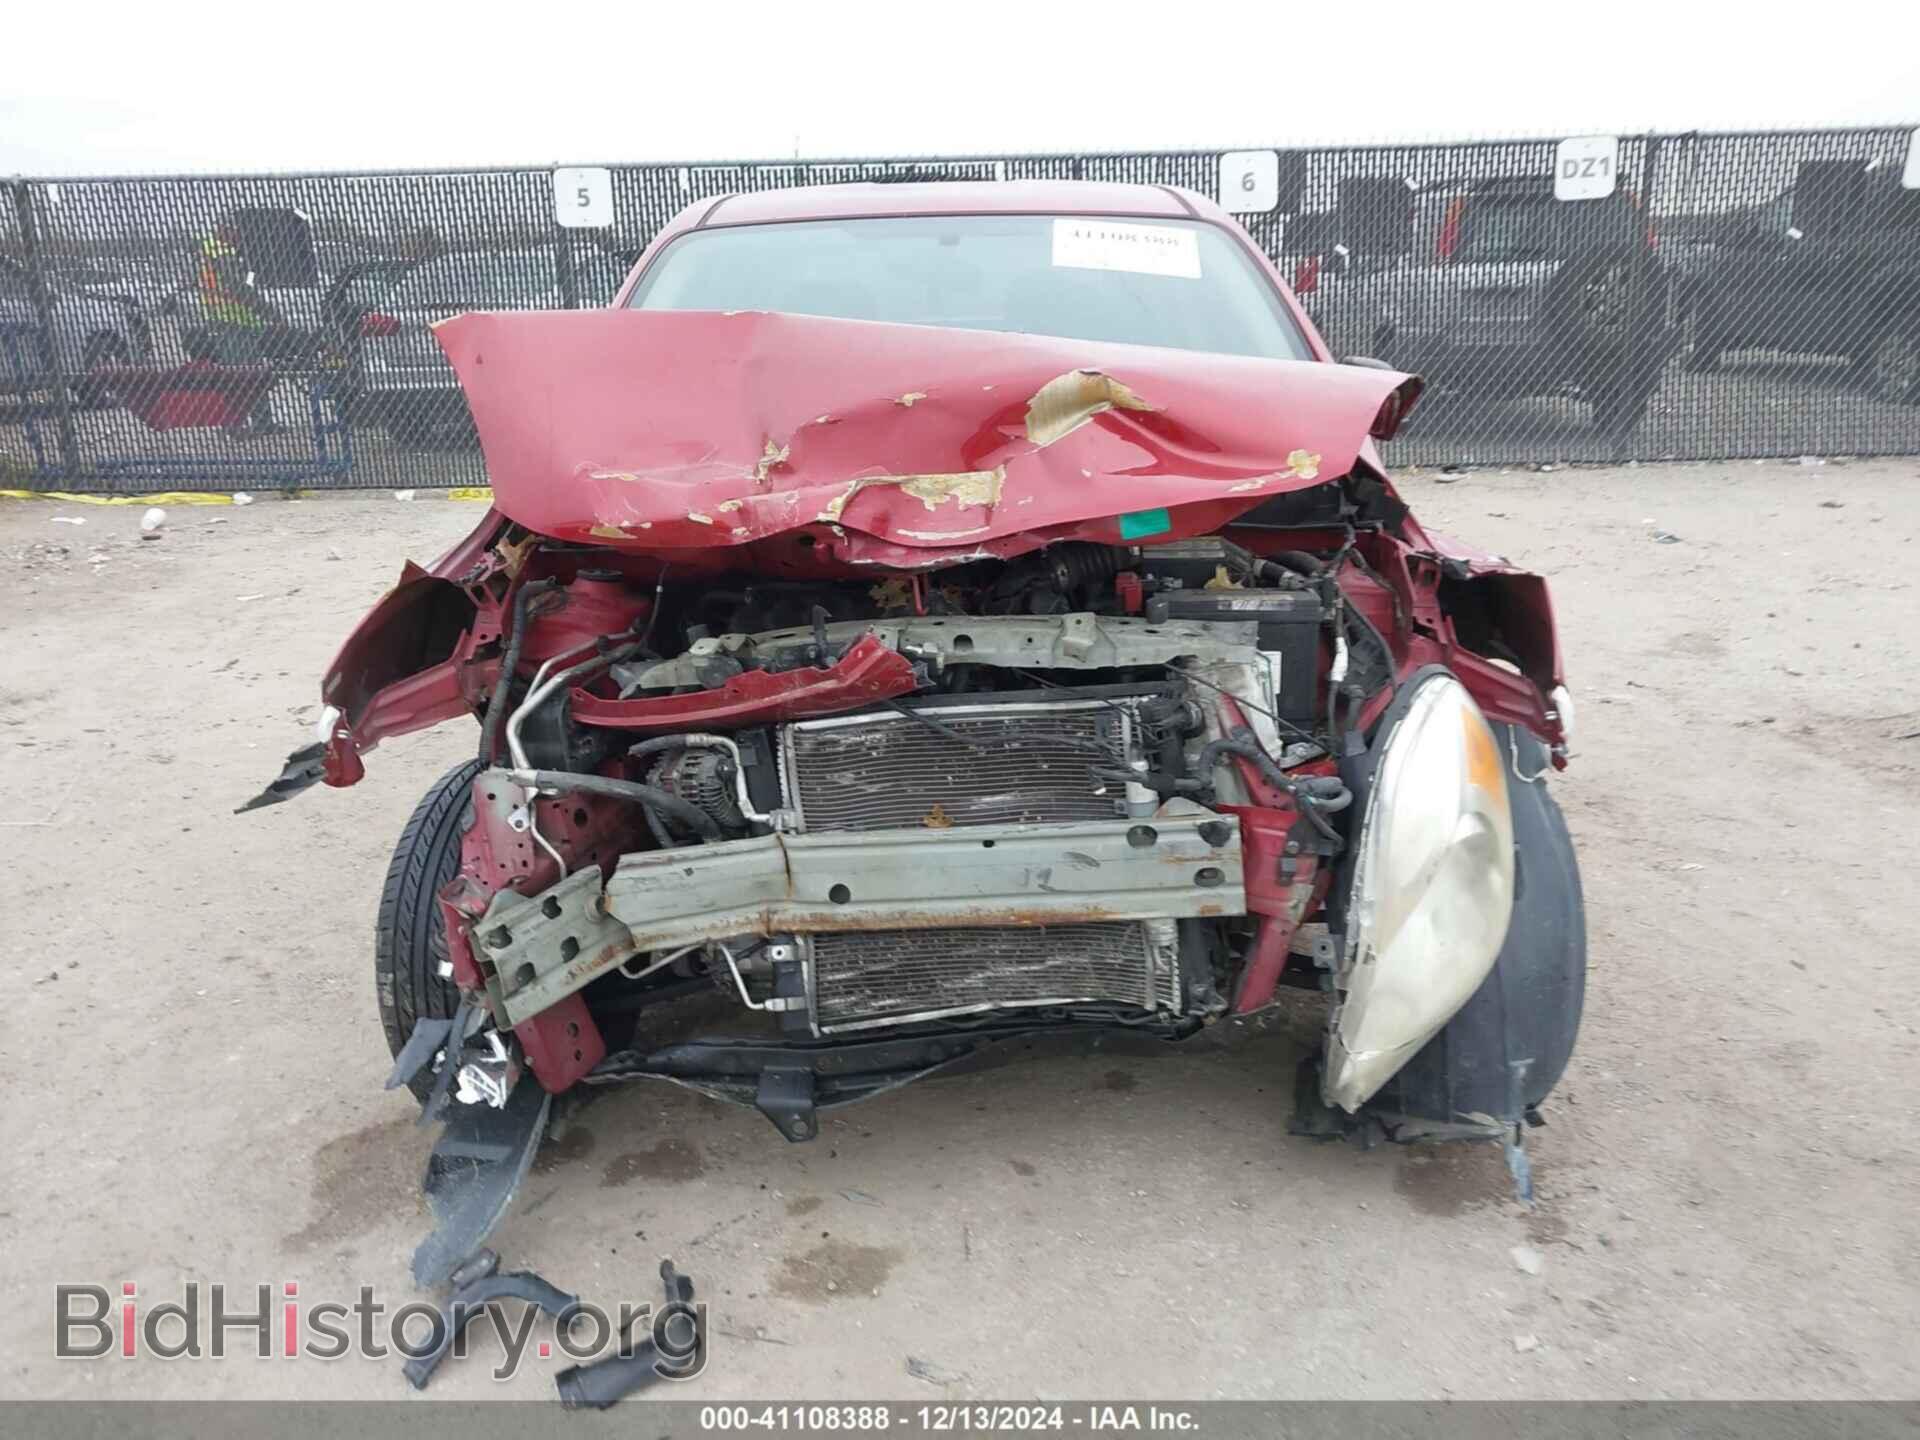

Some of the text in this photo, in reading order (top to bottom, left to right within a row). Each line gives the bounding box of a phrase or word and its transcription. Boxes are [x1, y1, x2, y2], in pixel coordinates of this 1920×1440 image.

[1562, 156, 1609, 179] DZ1
[1241, 171, 1255, 192] 6
[577, 188, 591, 207] 5
